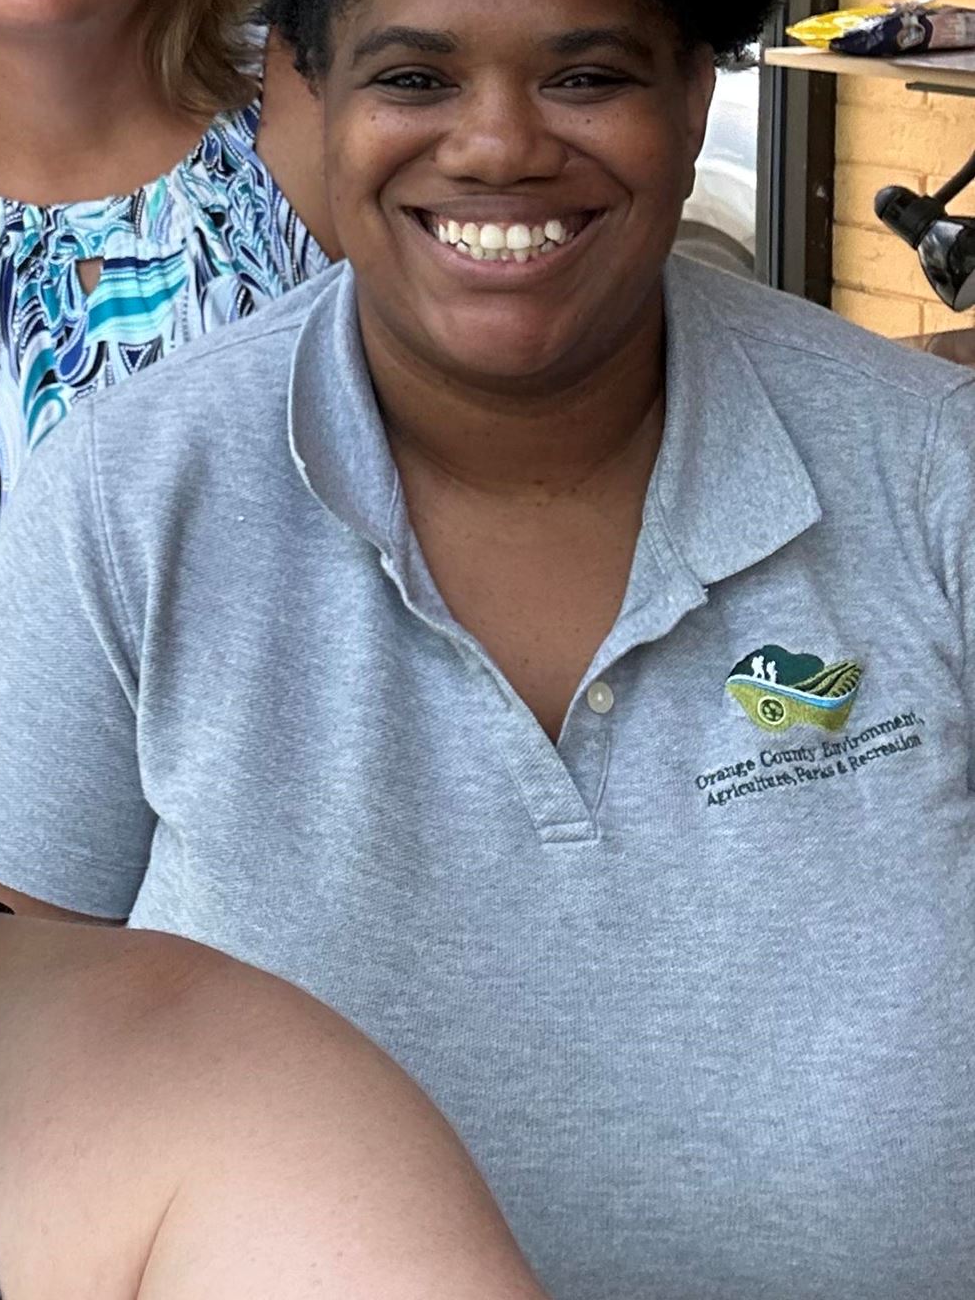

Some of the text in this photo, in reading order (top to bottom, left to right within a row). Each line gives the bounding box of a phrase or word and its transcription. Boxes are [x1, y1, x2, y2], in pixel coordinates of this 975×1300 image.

[695, 758, 756, 790] Orange
[760, 745, 816, 769] County
[796, 764, 835, 784] Parks
[837, 760, 848, 775] &
[850, 733, 923, 772] Recreation
